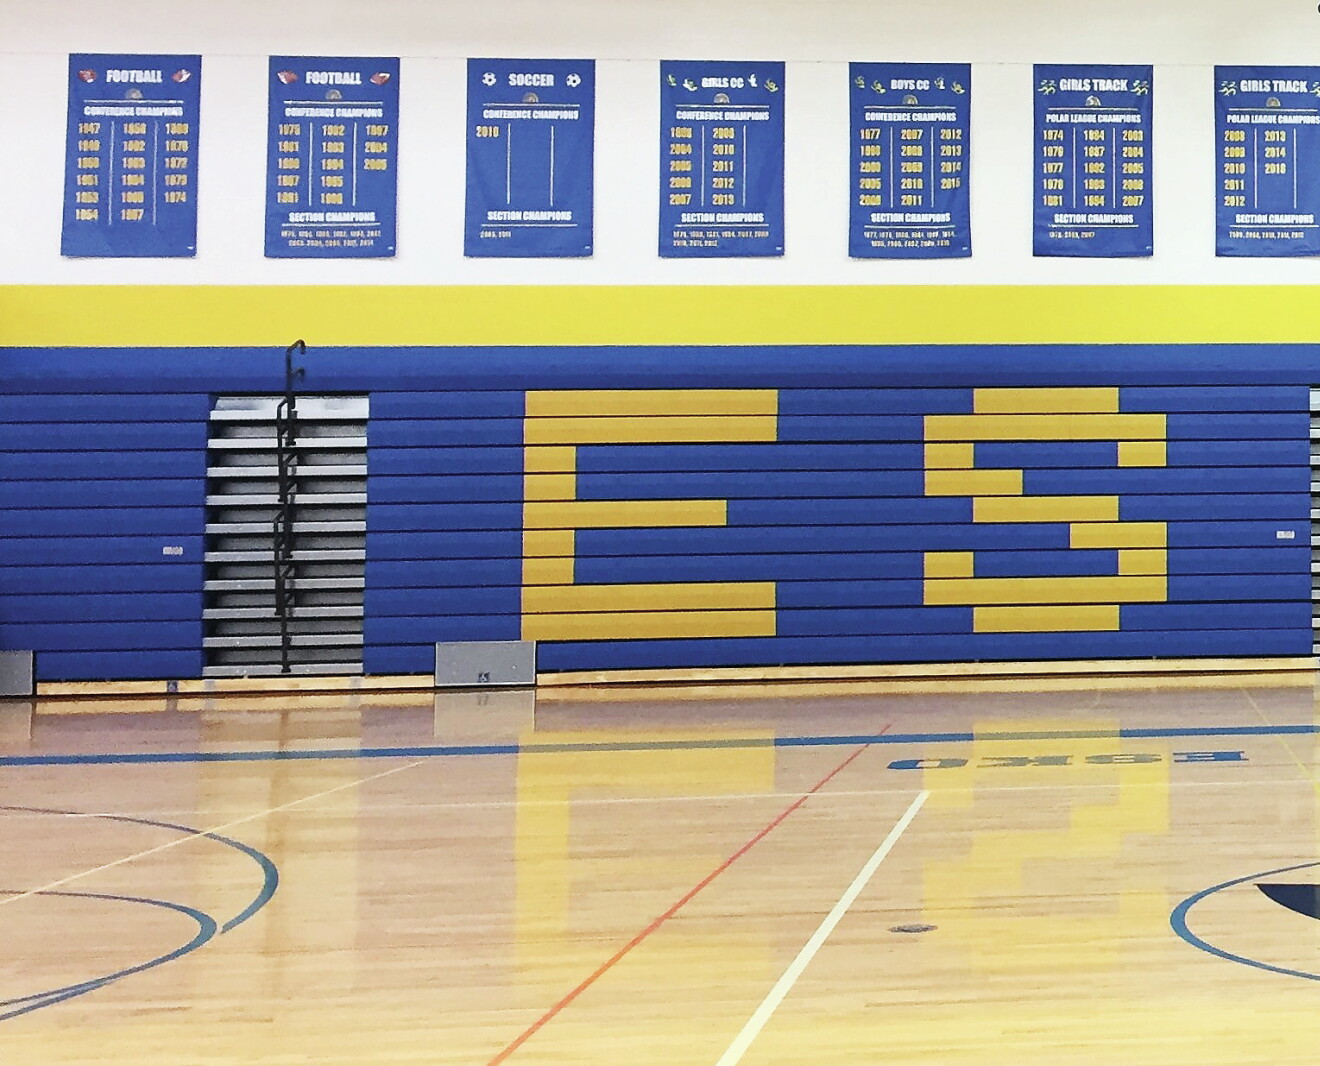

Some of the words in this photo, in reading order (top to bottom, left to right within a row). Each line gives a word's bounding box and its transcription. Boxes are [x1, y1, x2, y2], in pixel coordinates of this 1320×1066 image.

[107, 70, 163, 83] FOOTBALL
[306, 72, 363, 85] FOOTBALL
[509, 73, 555, 87] SOCCER
[702, 78, 728, 88] GIRLS
[730, 78, 745, 88] CC
[891, 79, 915, 90] BOYS
[917, 79, 930, 90] CC
[1060, 79, 1091, 91] GIRLS
[1092, 79, 1129, 91] TRACK
[1240, 80, 1271, 93] GIRLS
[1272, 80, 1308, 93] TRACK
[483, 110, 531, 119] CONFERENCE
[533, 110, 579, 119] CHAMPIONS
[677, 111, 724, 120] CONFERENCE
[725, 111, 770, 120] CHAMPIONS
[912, 112, 957, 121] CHAMPIONS
[1046, 114, 1069, 123] POLAR
[1071, 114, 1096, 123] LEAGUE
[1098, 114, 1142, 123] CHAMPIONS
[1227, 115, 1250, 125] POLAR
[1251, 115, 1276, 125] LEAGUE
[1278, 115, 1320, 125] CHAMPIONS
[477, 126, 500, 137] 2010
[942, 129, 962, 139] 2012
[1266, 130, 1287, 142] 2013
[942, 145, 962, 156] 2013
[1266, 147, 1287, 158] 2014
[714, 161, 734, 171] 2011
[714, 178, 735, 188] 2012
[1225, 179, 1245, 190] 2011
[902, 195, 923, 205] 2011
[1225, 196, 1246, 206] 2012
[289, 212, 324, 223] SECTION
[326, 212, 376, 223] CHAMPIONS
[488, 211, 522, 221] SECTION
[523, 211, 573, 221] CHAMPIONS
[682, 213, 715, 222] SECTION
[716, 213, 765, 222] CHAMPIONS
[871, 213, 904, 223] SECTION
[905, 213, 951, 223] CHAMPIONS
[1054, 214, 1087, 223] SECTION
[1088, 214, 1134, 223] CHAMPIONS
[1236, 214, 1268, 224] SECTION
[1269, 214, 1315, 224] CHAMPIONS
